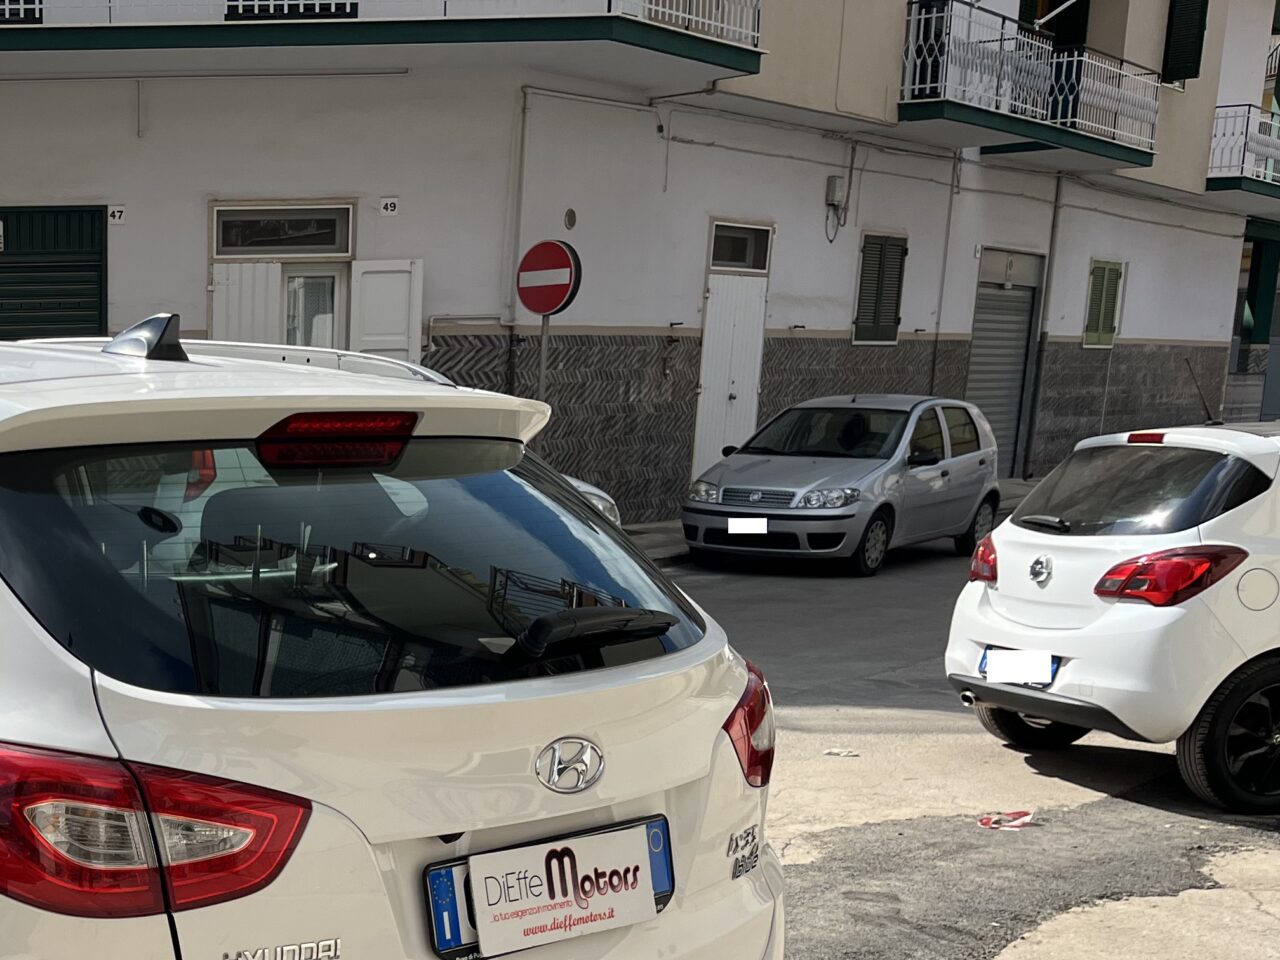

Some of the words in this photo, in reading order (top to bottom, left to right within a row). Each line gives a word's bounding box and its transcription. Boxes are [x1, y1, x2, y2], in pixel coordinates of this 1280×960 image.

[383, 202, 397, 212] 49
[109, 210, 124, 220] 47
[523, 907, 615, 937] www.dieffemotors.it
